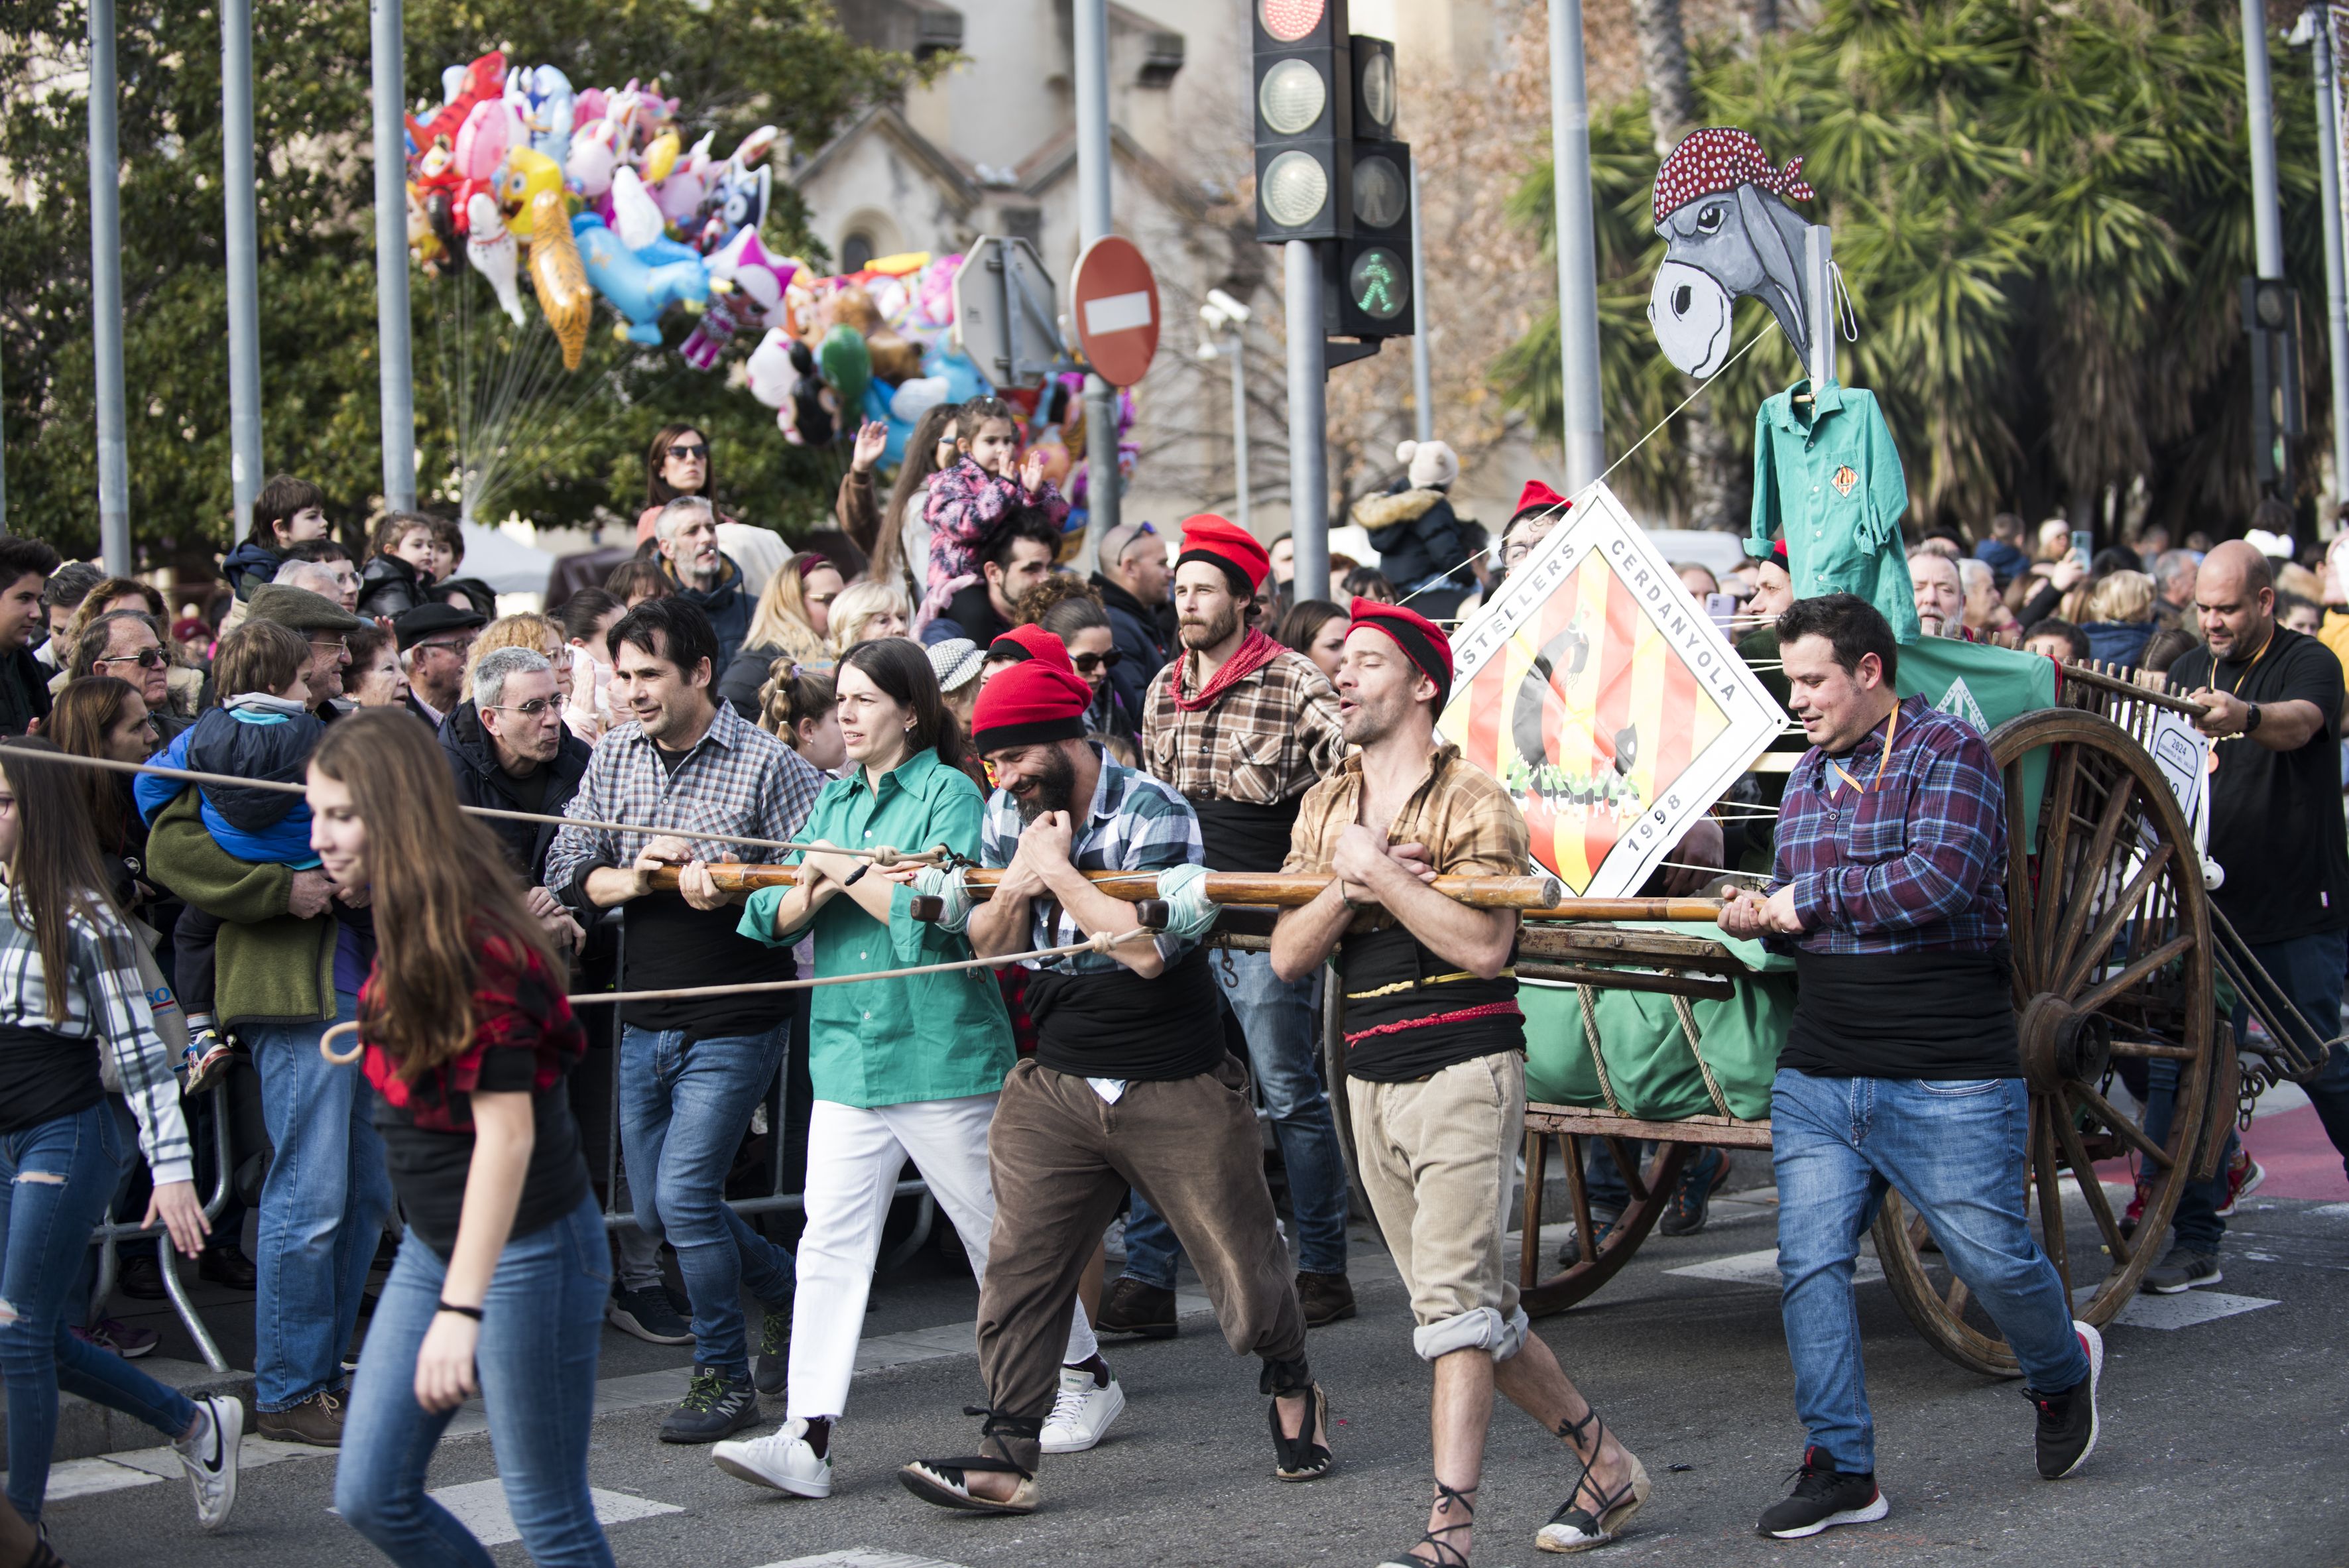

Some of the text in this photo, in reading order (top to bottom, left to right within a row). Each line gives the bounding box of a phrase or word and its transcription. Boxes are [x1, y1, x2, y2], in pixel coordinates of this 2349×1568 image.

[1453, 544, 1575, 682] ASTELLERS
[1611, 539, 1736, 701] CERDANYOLA
[1937, 689, 1954, 711] LLERS
[1963, 690, 1987, 731] CERDANYO
[2171, 738, 2187, 756] 2024
[1628, 794, 1681, 852] 1998
